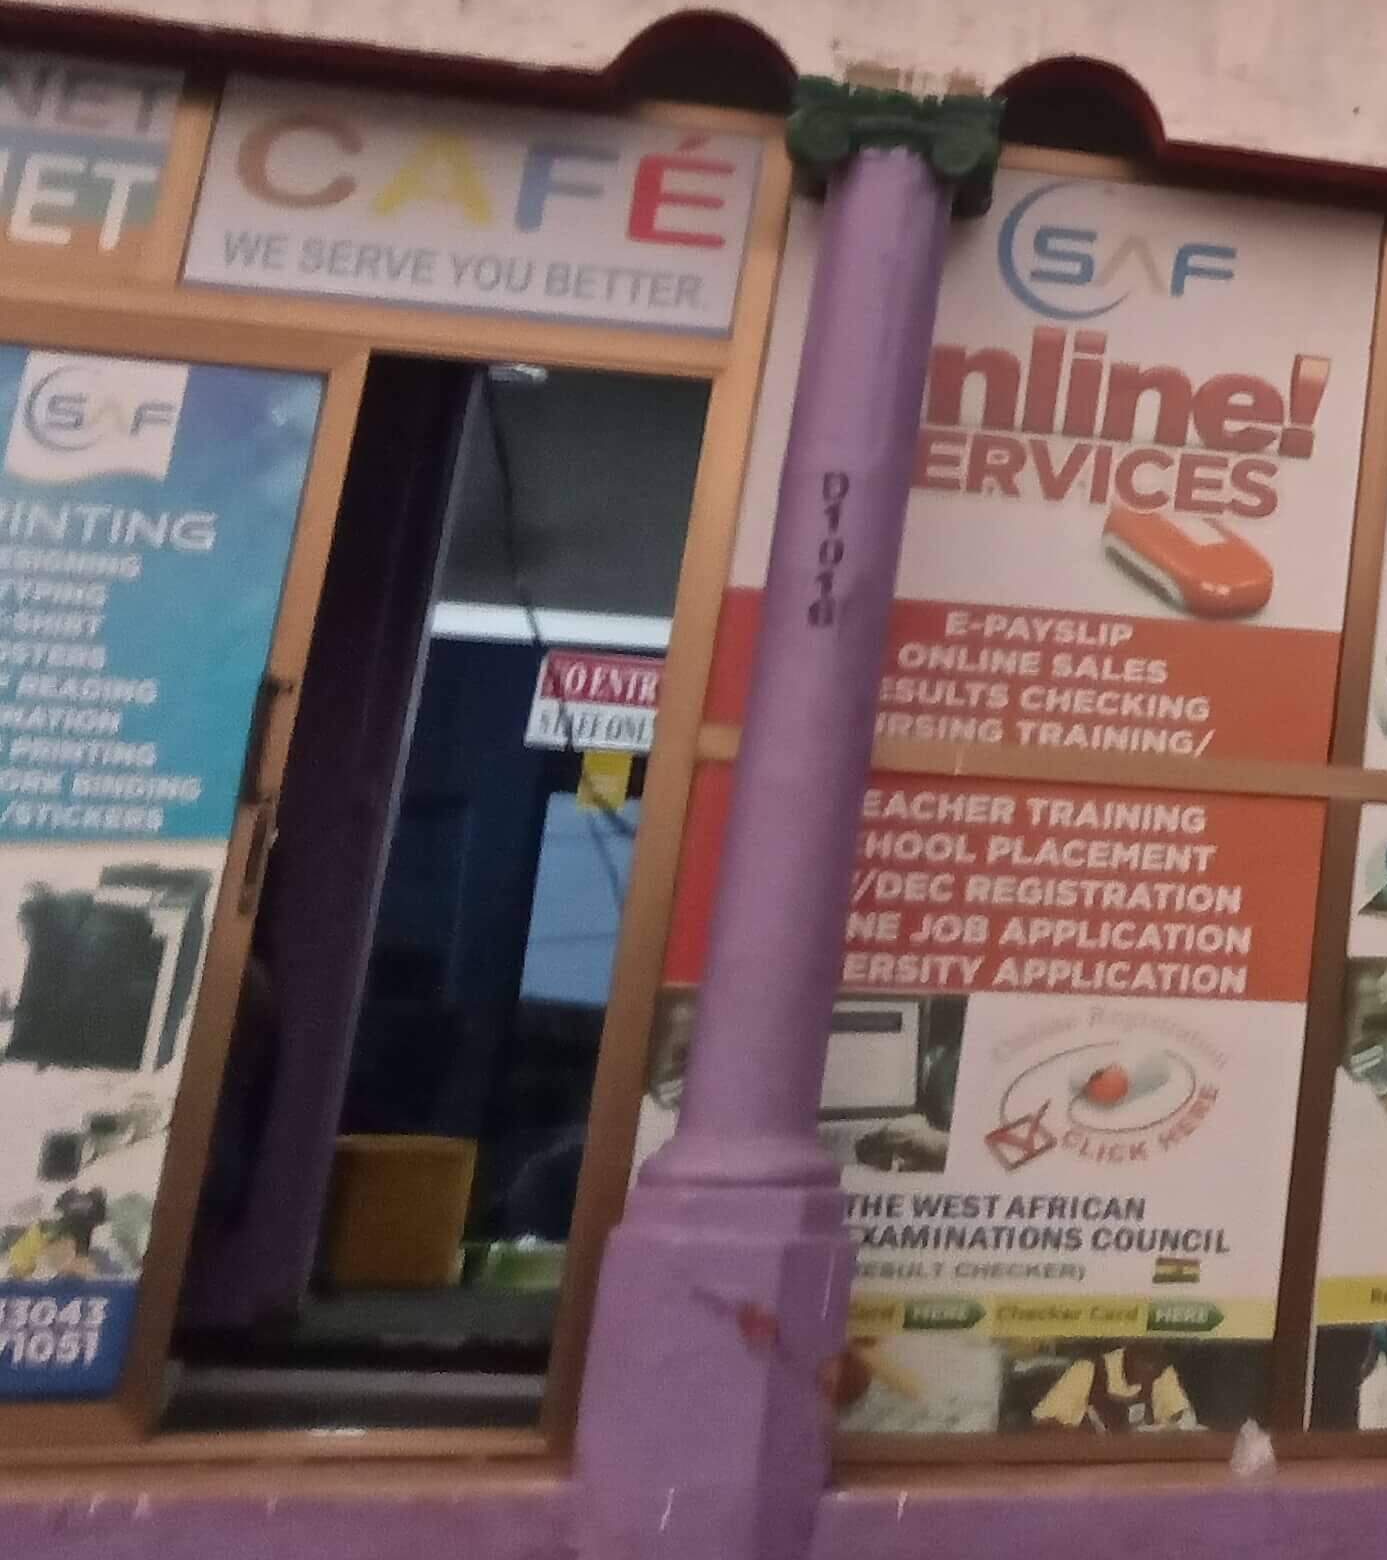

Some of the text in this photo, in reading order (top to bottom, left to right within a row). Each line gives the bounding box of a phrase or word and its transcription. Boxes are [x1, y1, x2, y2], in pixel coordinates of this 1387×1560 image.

[0, 148, 161, 251] ET
[237, 112, 735, 249] CAFÉ
[222, 229, 290, 270] WE
[297, 237, 437, 287] SERVE
[450, 251, 535, 296] YOU
[1030, 226, 1239, 298] SAF
[945, 611, 1134, 647] E-PAYSLIP
[899, 642, 1168, 685] ONLINE SALES
[1020, 685, 1212, 723] CHECKING
[1016, 719, 1216, 759] TRAINING/
[1026, 797, 1208, 835] TRAINING
[857, 830, 1218, 874] HOOL PLACEMENT
[851, 869, 1243, 916] /DEC REGISTRATION
[909, 913, 990, 945] JOB
[999, 916, 1253, 956] APPLICATION
[992, 956, 1249, 995] APPLICATION
[1061, 1128, 1148, 1164] CLICK
[844, 1192, 1147, 1221] THE WEST AFRICAN
[1091, 1227, 1232, 1254] COUNCIL
